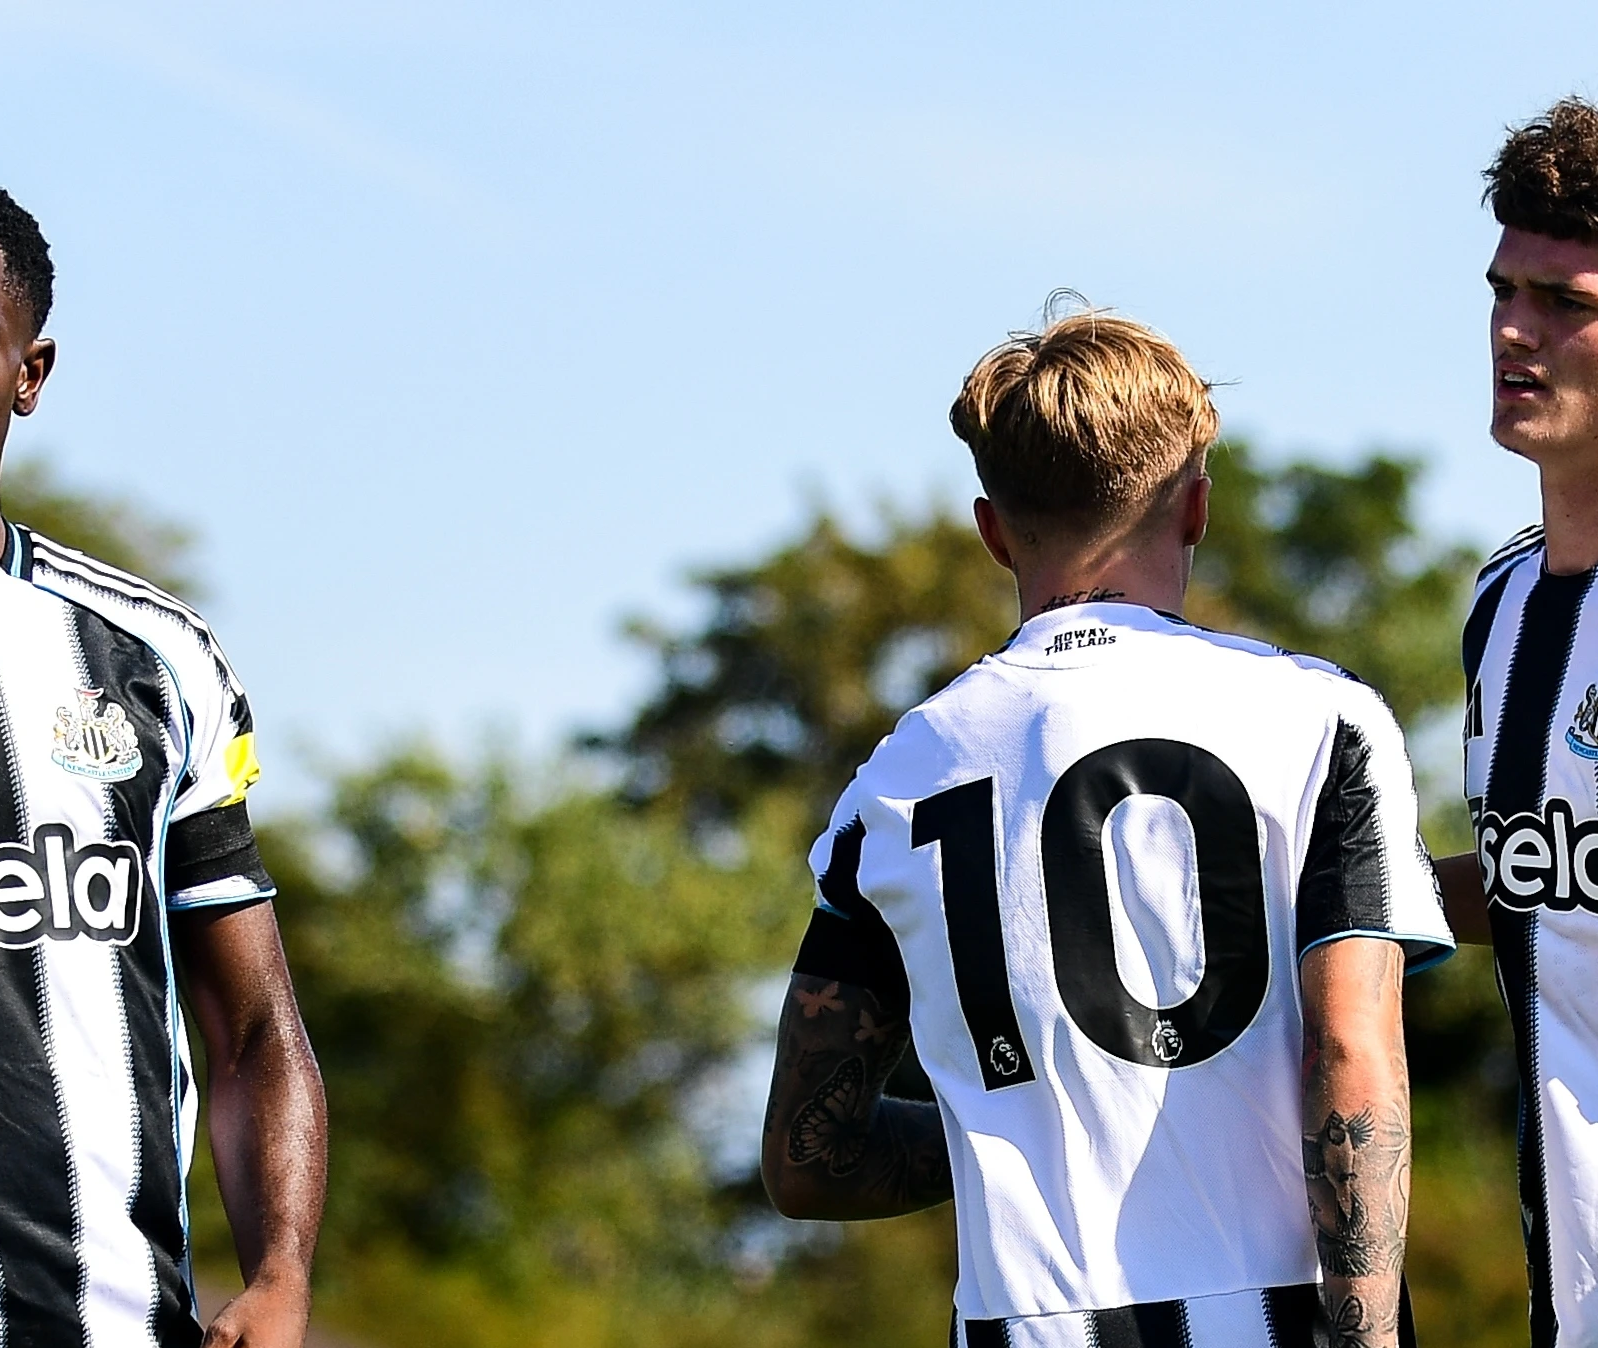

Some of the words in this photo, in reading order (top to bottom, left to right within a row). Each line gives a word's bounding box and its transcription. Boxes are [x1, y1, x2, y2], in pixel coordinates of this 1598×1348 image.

[1044, 641, 1073, 657] THE
[1077, 635, 1117, 649] LADS
[1053, 627, 1109, 646] HOWAY
[910, 737, 1270, 1092] 10
